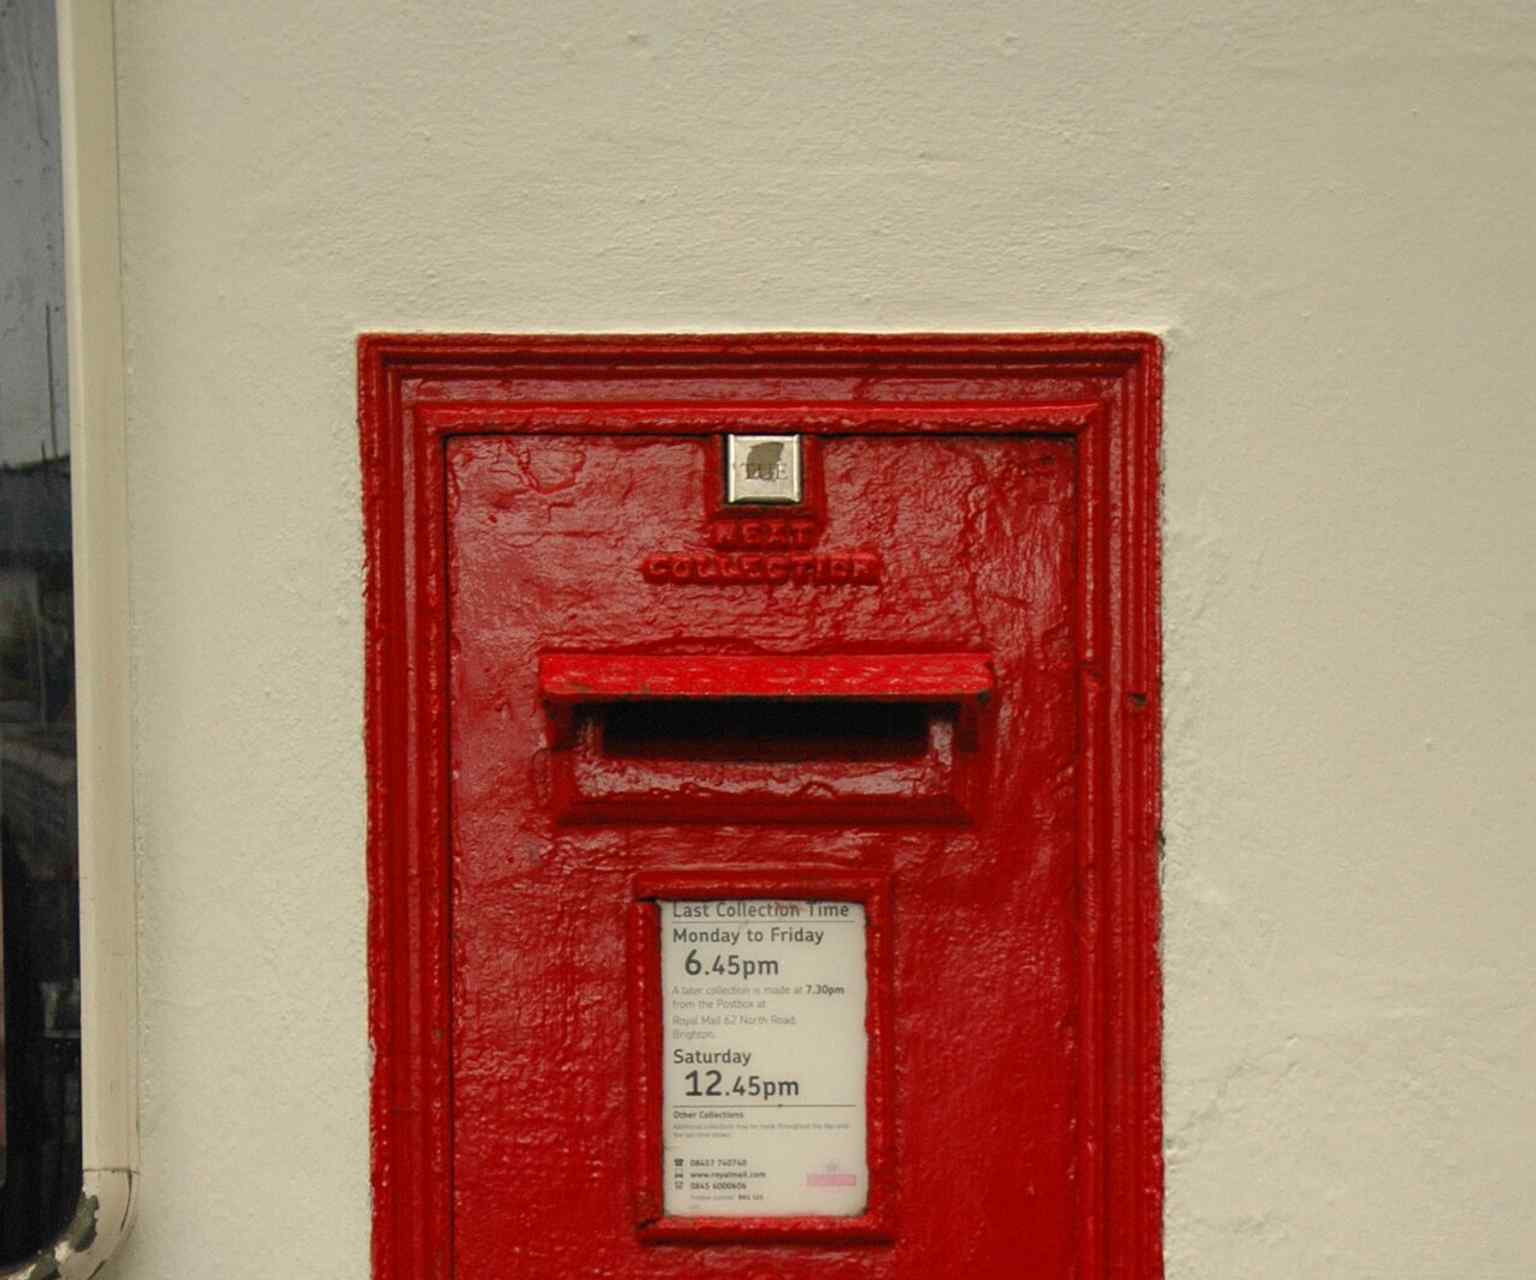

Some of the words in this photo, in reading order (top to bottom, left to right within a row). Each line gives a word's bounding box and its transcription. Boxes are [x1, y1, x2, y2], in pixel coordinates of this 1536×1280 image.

[673, 902, 710, 918] Last
[716, 902, 801, 918] Collection
[808, 902, 850, 918] Time
[673, 928, 742, 945] Monday
[747, 929, 764, 943] to
[771, 927, 825, 945] Friday
[685, 948, 779, 980] 6.45pm
[805, 985, 845, 996] 7.30pm
[672, 999, 696, 1009] from
[698, 999, 713, 1009] the
[716, 999, 754, 1009] Postbox
[756, 999, 766, 1009] at
[672, 1015, 698, 1027] Royal
[701, 1015, 721, 1025] Mail
[740, 1015, 768, 1025] North
[673, 1049, 752, 1067] Saturday
[685, 1070, 800, 1100] 12.45pm
[673, 1111, 698, 1120] Other
[699, 1111, 744, 1120] Collections
